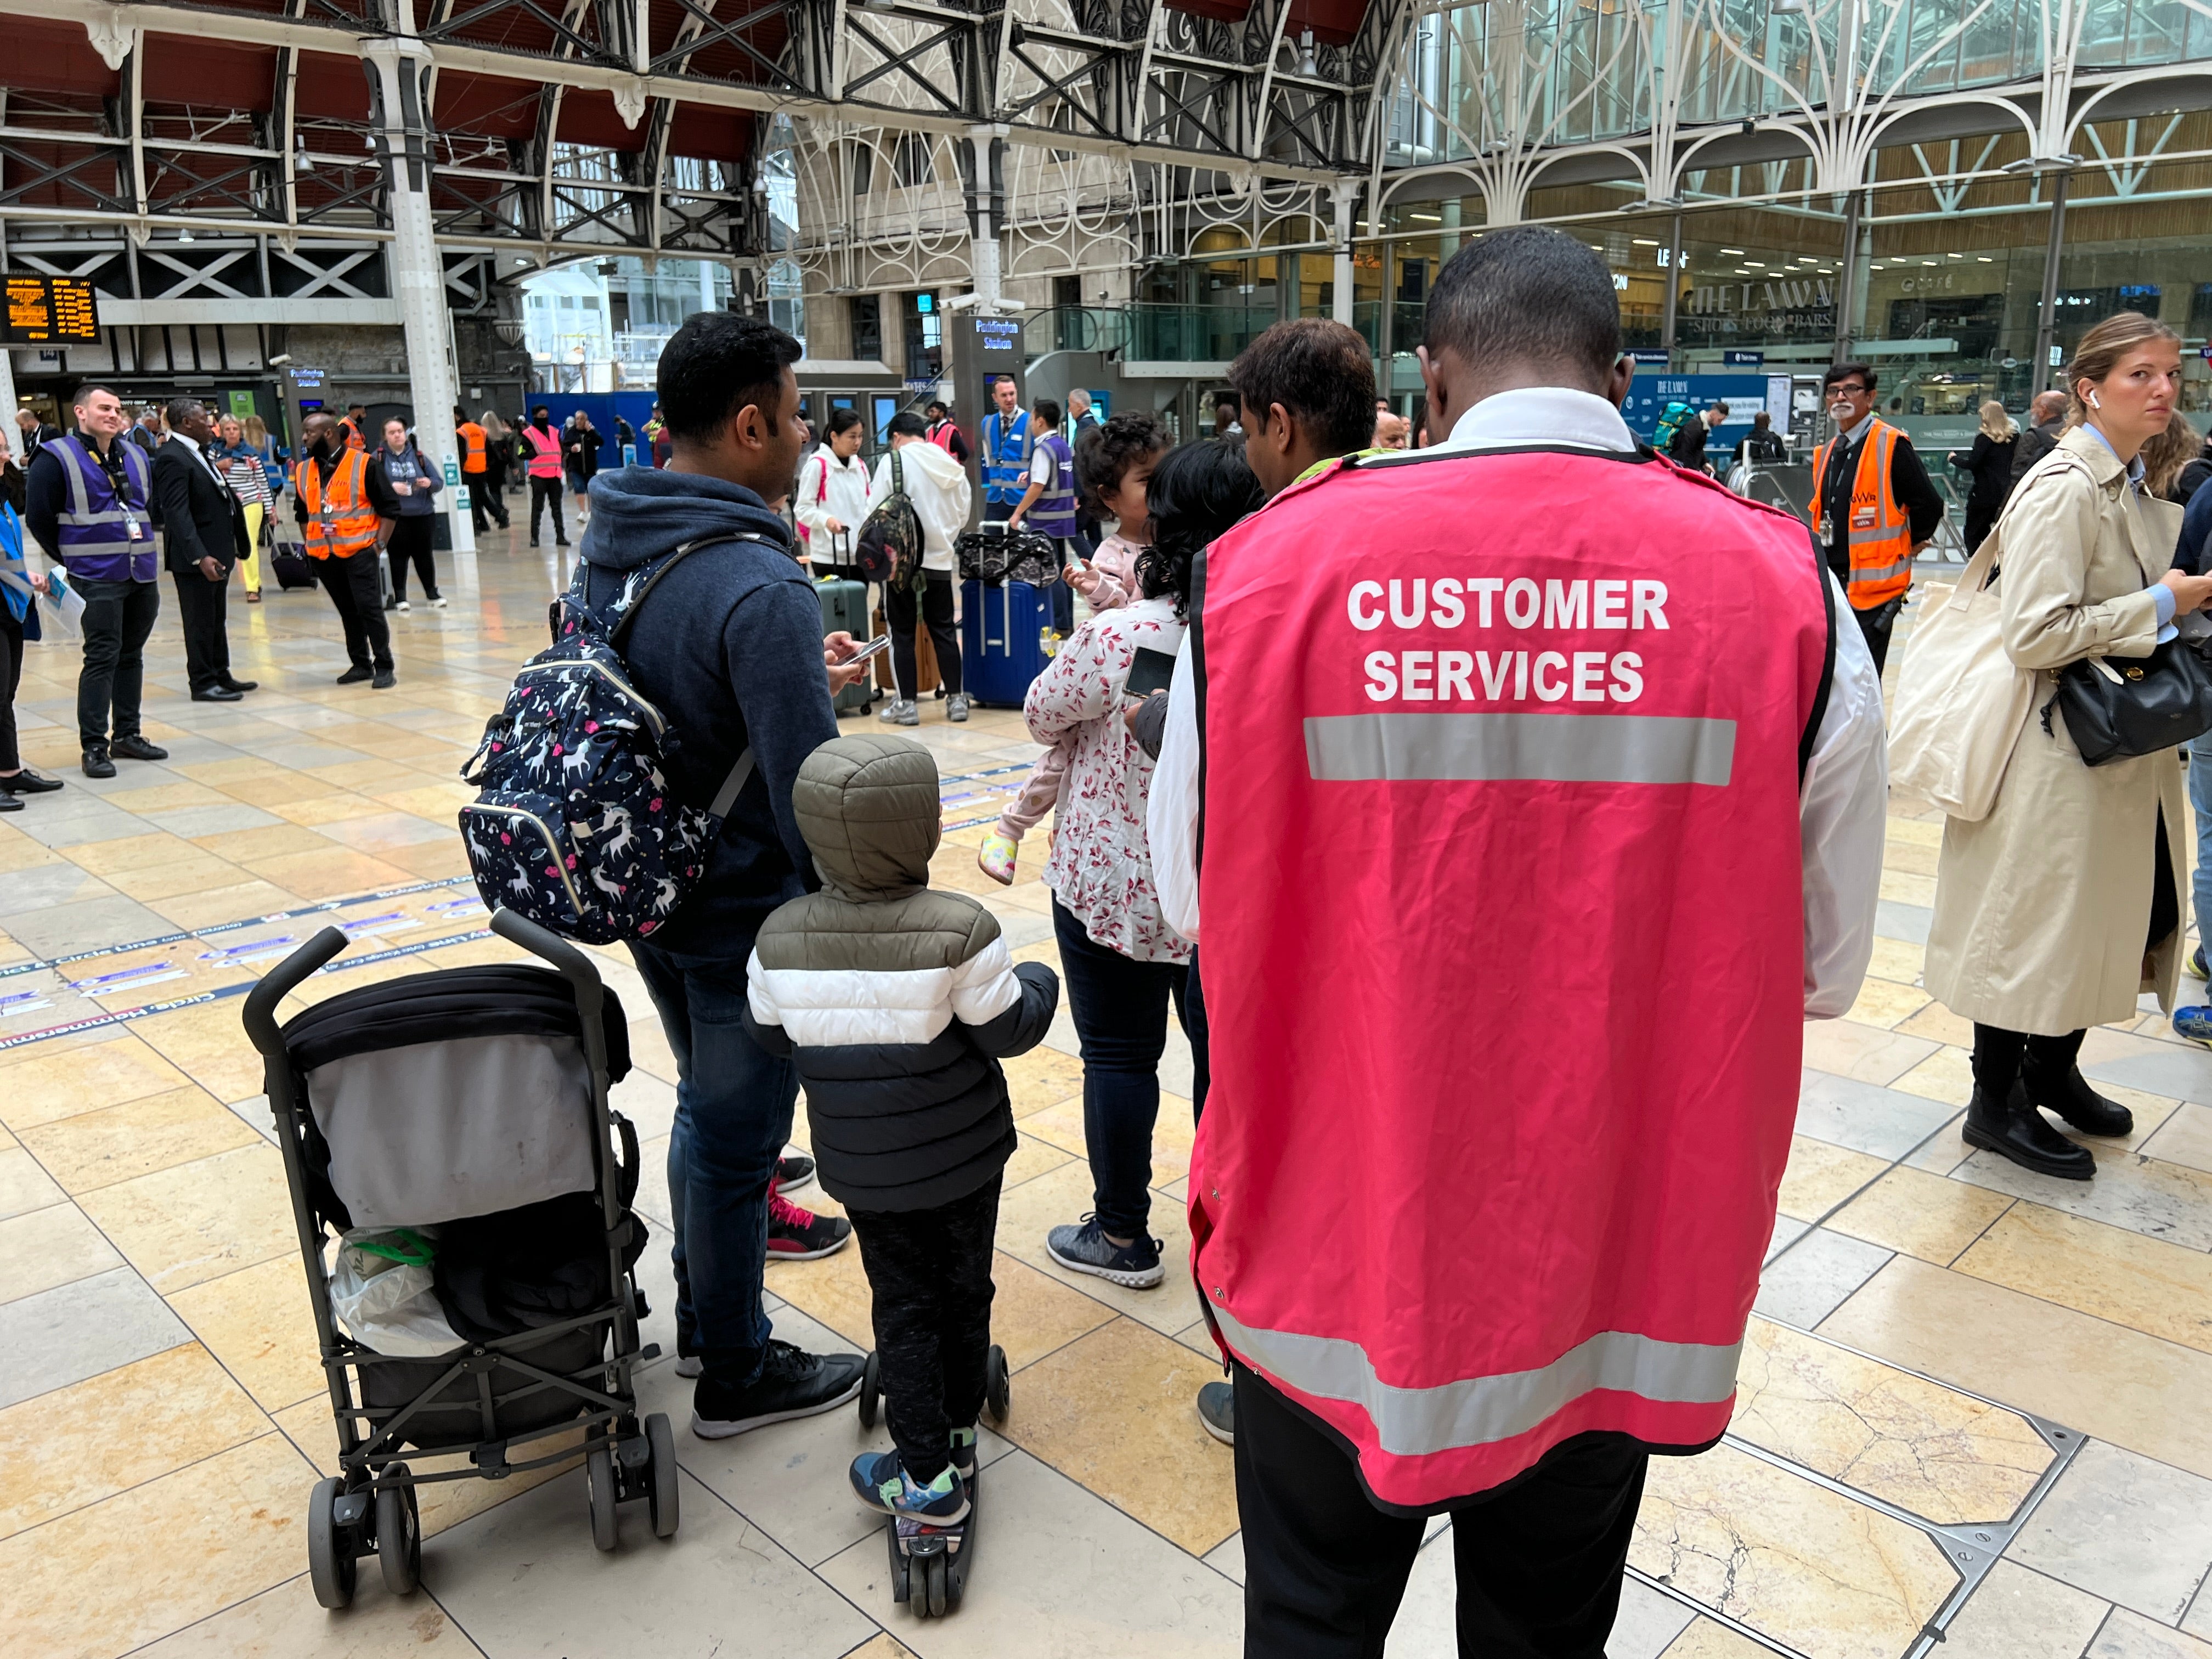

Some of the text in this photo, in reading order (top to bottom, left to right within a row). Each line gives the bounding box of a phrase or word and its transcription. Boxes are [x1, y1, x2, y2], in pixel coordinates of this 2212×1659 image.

[1656, 248, 1686, 269] LEN
[1739, 278, 1836, 312] LAWN
[975, 320, 1018, 335] Paddington
[1795, 313, 1831, 328] BARS
[1347, 578, 1671, 631] CUSTOMER
[1363, 651, 1644, 703] SERVICES
